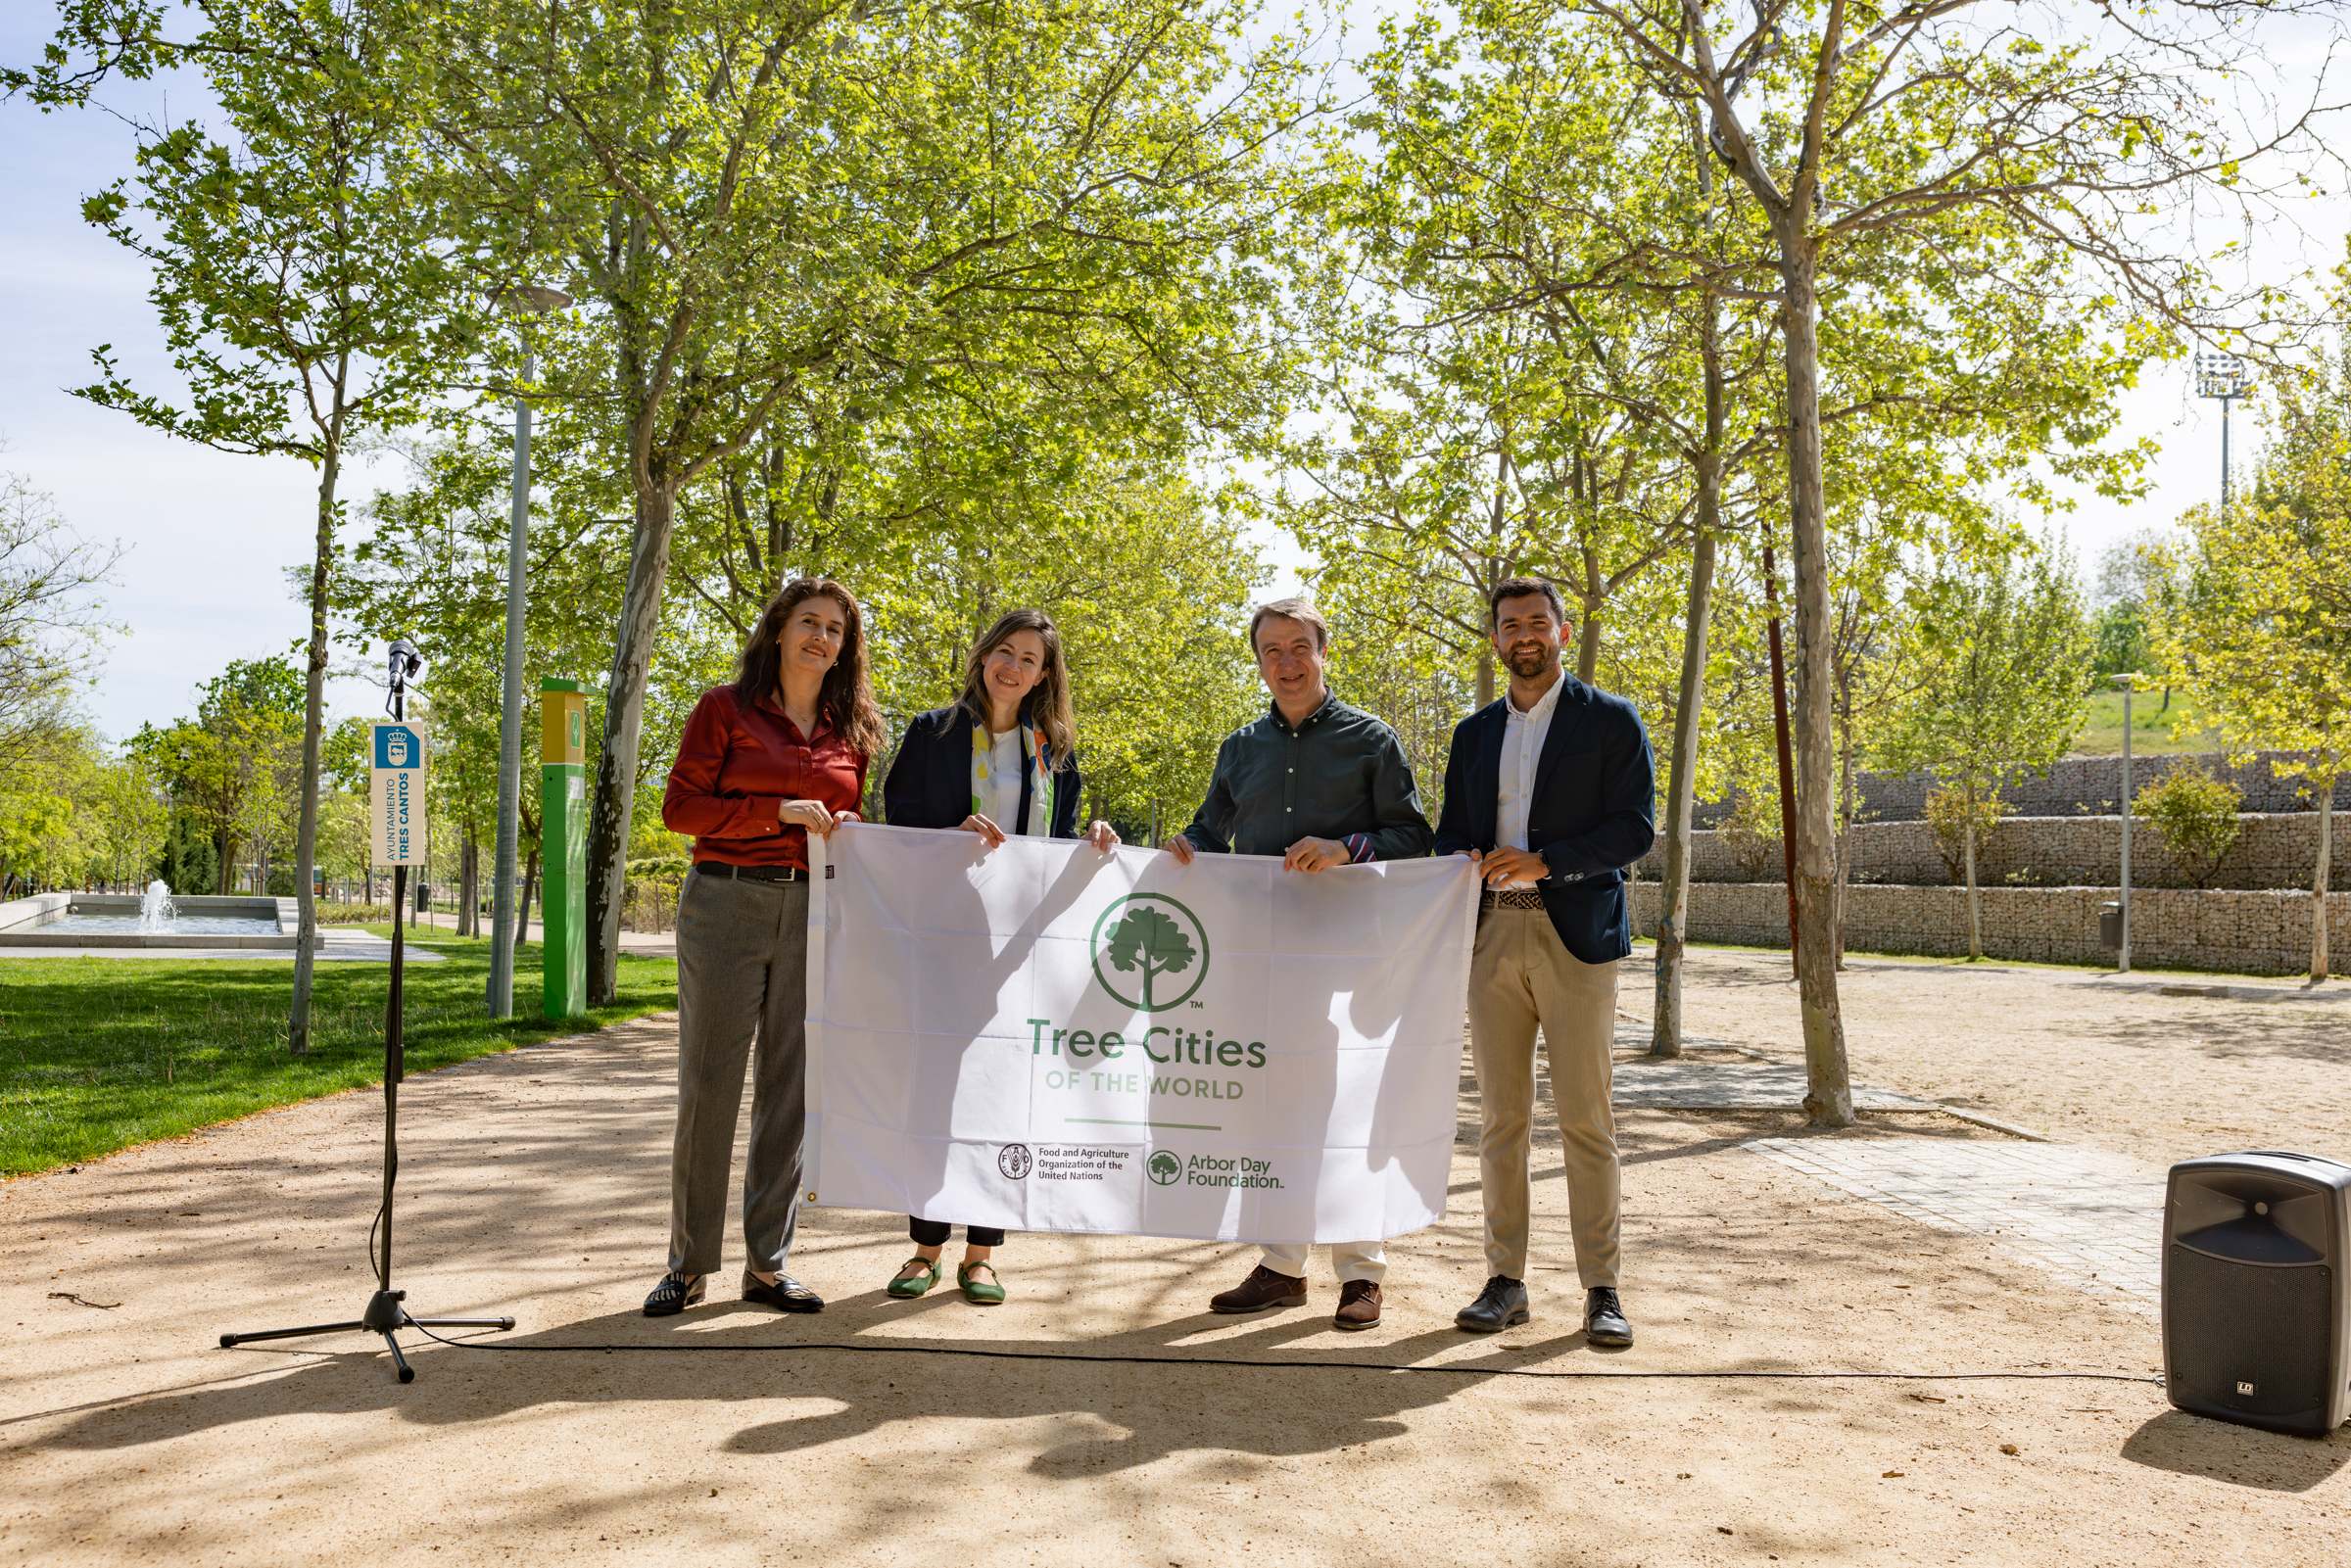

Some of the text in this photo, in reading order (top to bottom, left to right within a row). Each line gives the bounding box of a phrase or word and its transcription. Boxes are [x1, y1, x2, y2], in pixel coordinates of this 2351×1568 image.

[399, 773, 408, 861] TRES CANTOS
[1027, 1019, 1267, 1069] Tree Cities
[1045, 1070, 1244, 1100] OF THE WORLD
[1038, 1148, 1060, 1157] Food
[1080, 1149, 1129, 1160] Agriculture
[1038, 1160, 1123, 1170] Organization of the
[1038, 1170, 1103, 1180] United Nations
[1187, 1155, 1271, 1175] Arbor Day
